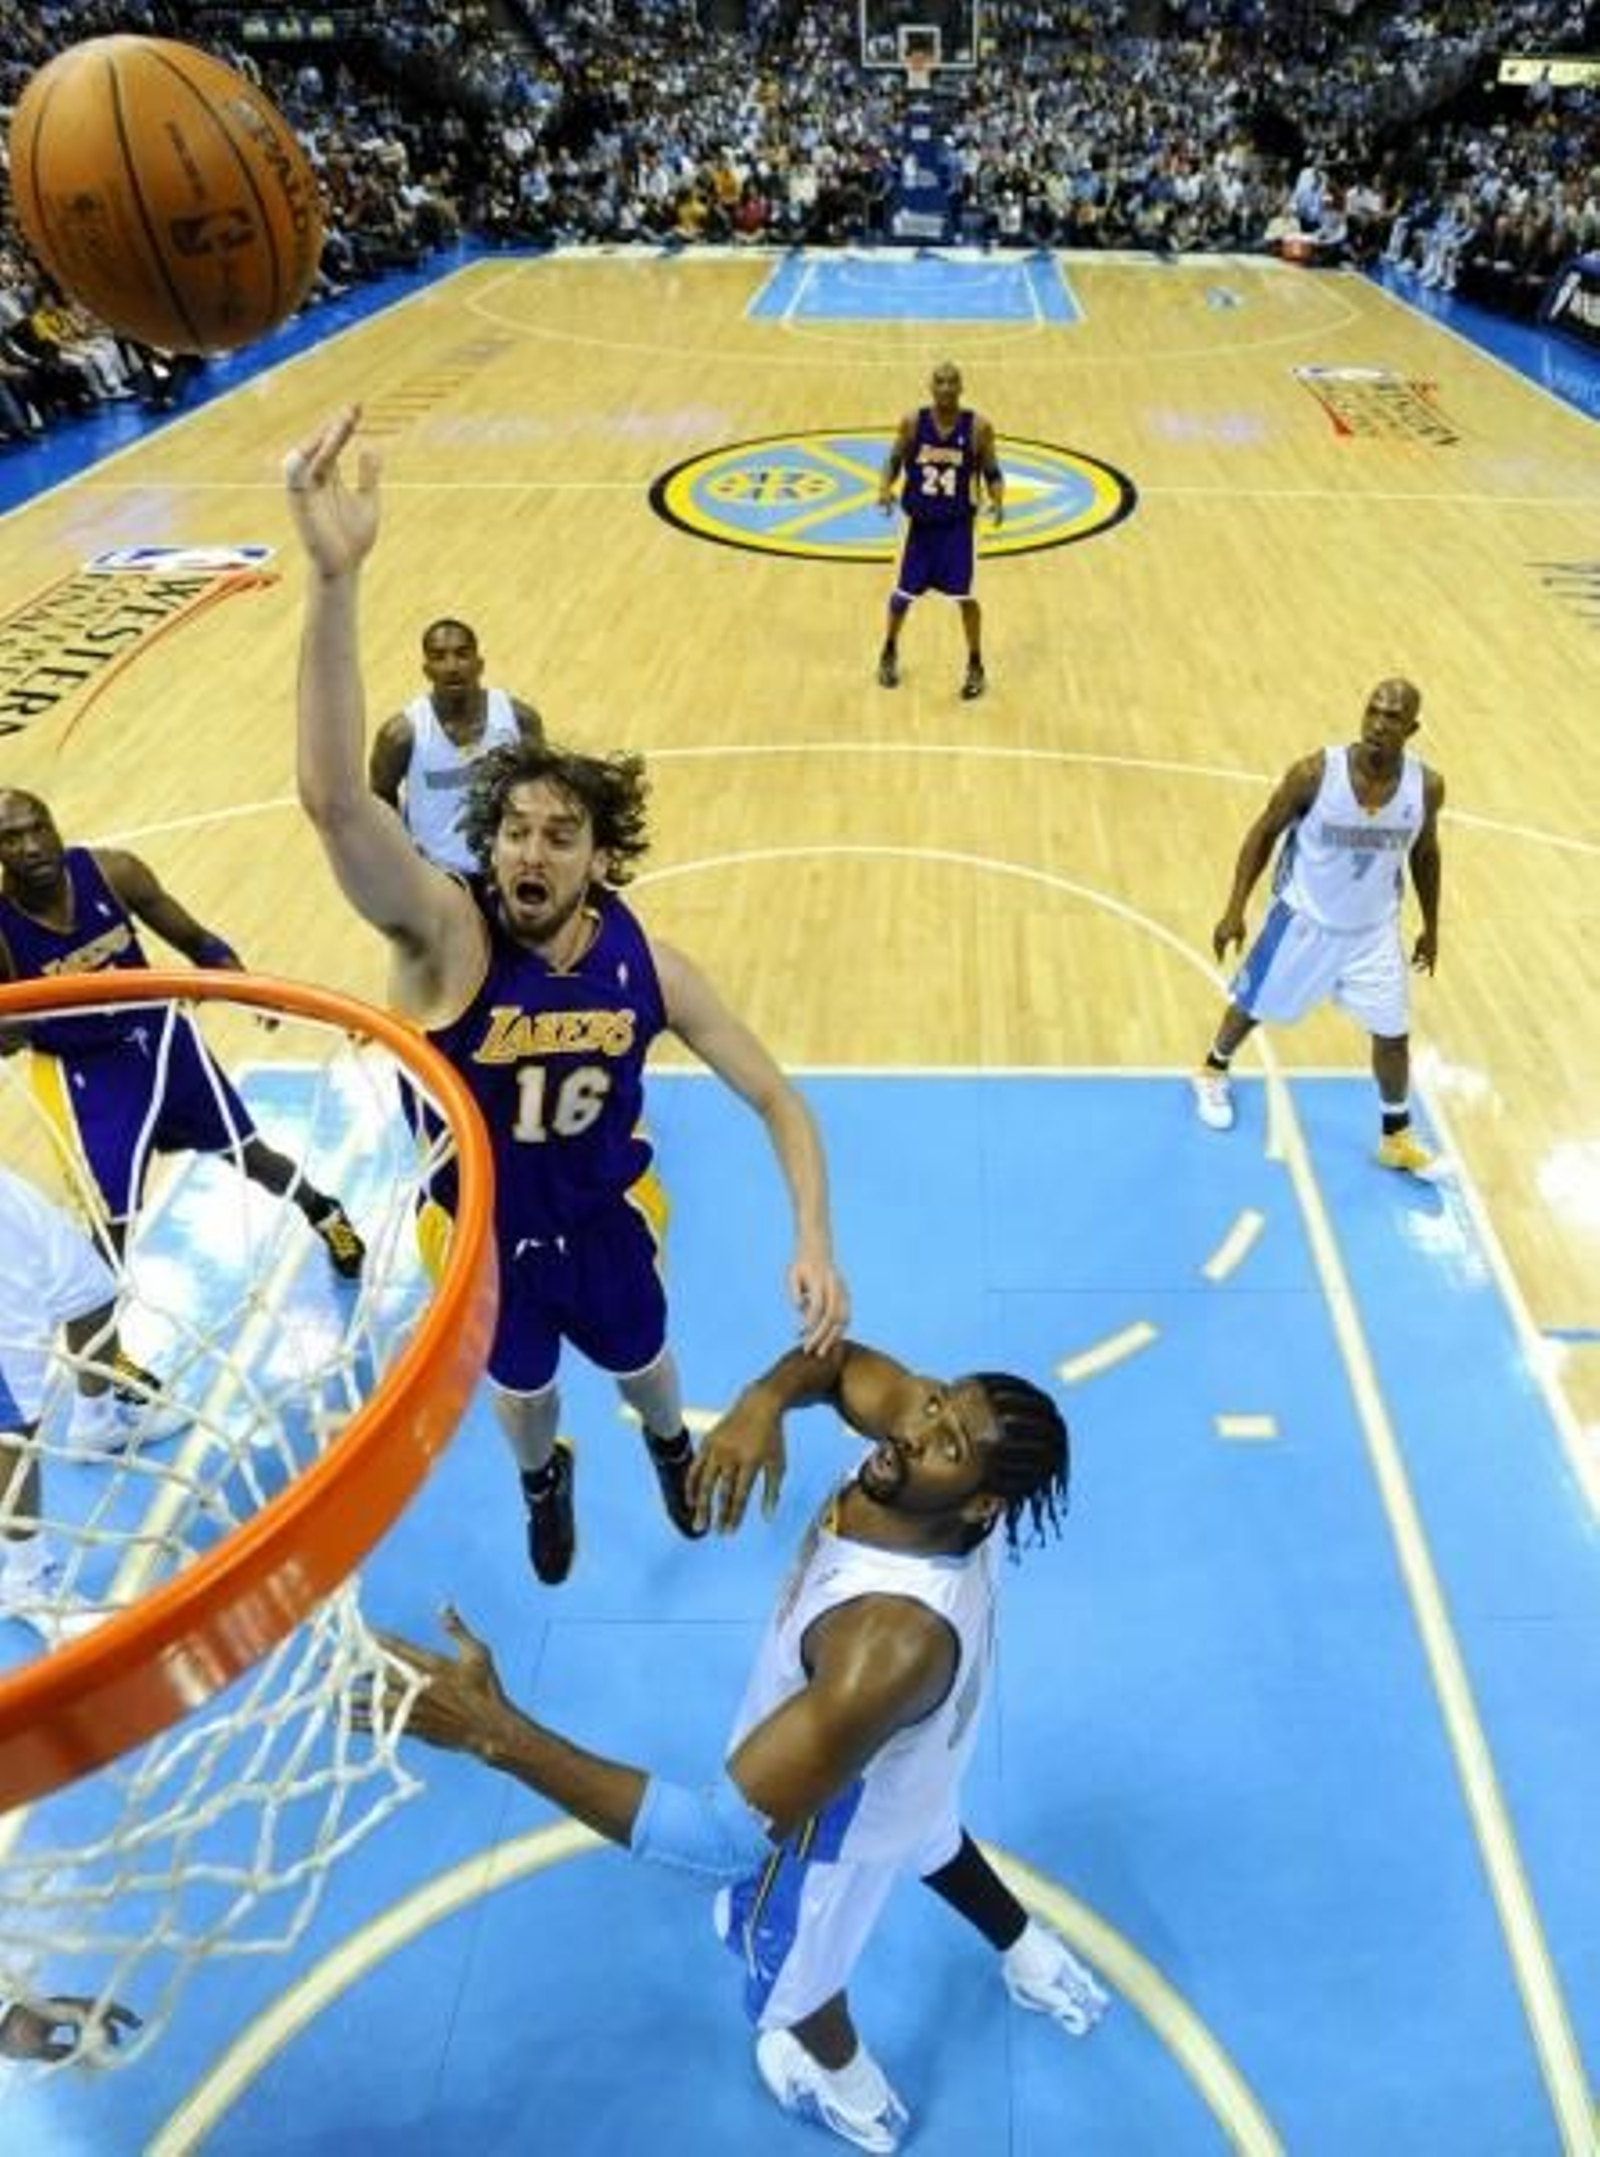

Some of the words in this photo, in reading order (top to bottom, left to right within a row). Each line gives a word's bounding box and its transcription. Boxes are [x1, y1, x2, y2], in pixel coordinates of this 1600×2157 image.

[921, 465, 956, 496] 24
[1351, 853, 1376, 880] 7
[472, 1006, 636, 1063] LAKERS
[513, 1065, 610, 1142] 16
